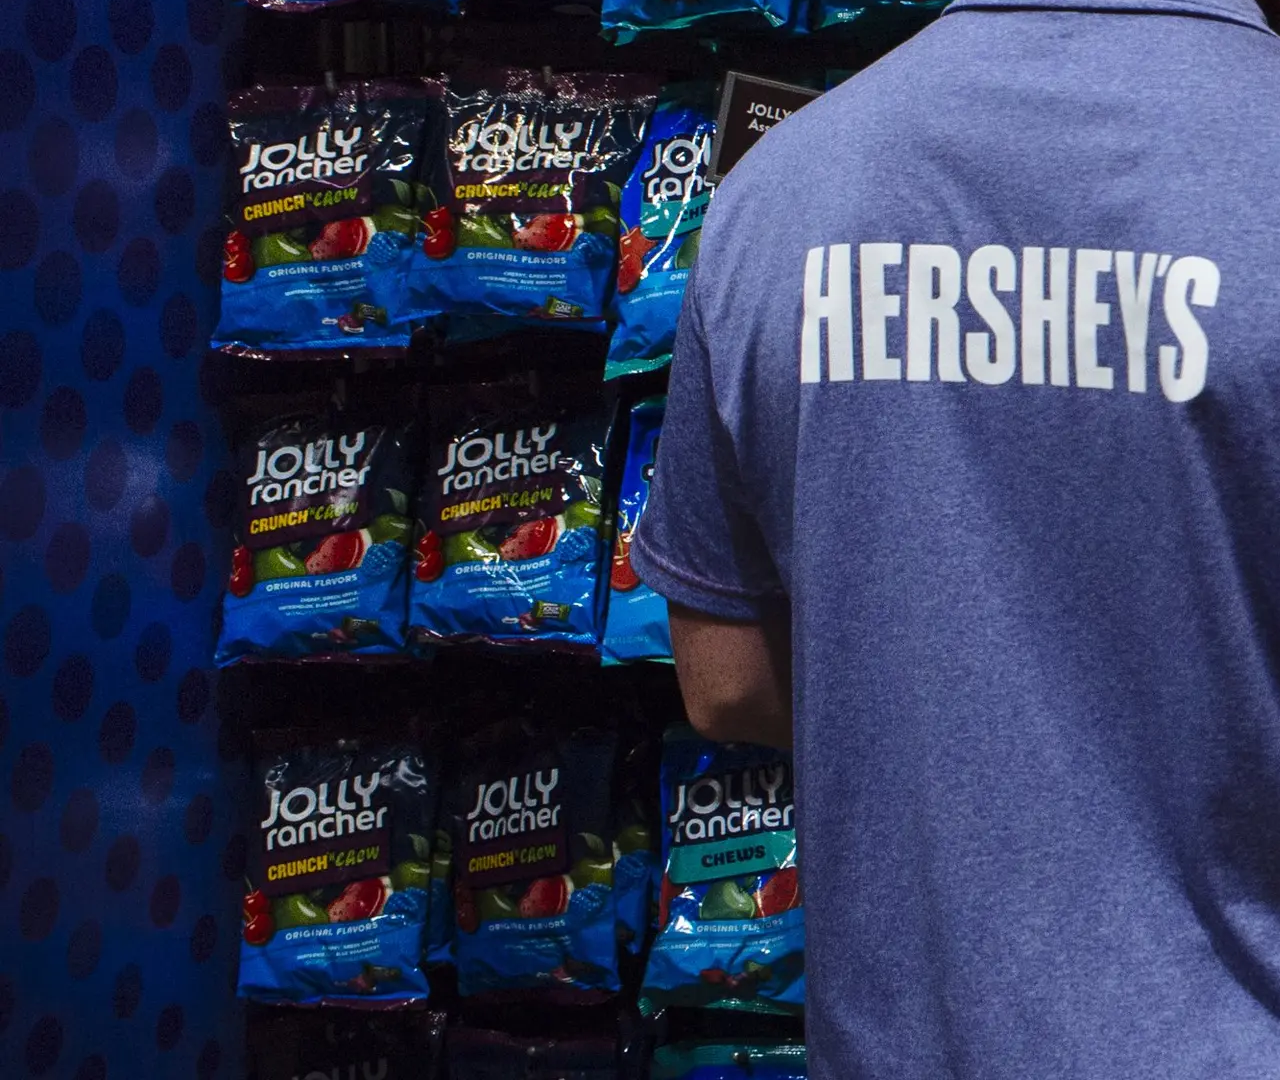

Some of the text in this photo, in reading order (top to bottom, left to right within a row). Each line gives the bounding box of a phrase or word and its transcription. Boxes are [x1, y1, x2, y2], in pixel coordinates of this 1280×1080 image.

[746, 102, 792, 120] JOLLY
[800, 242, 1222, 403] HERSHEY'S
[247, 432, 365, 485] JOLLY
[251, 466, 370, 505] rancher
[250, 510, 308, 535] CRUNCH
[266, 573, 358, 592] ORIGINAL FLAVORS
[261, 772, 380, 829] JOLLY
[670, 763, 785, 823] JOLLY
[266, 807, 388, 851] rancher
[675, 804, 794, 843] rancher
[267, 855, 328, 882] CRUNCH
[701, 845, 766, 867] CHEWS
[285, 921, 379, 941] ORIGINAL FLAVORS
